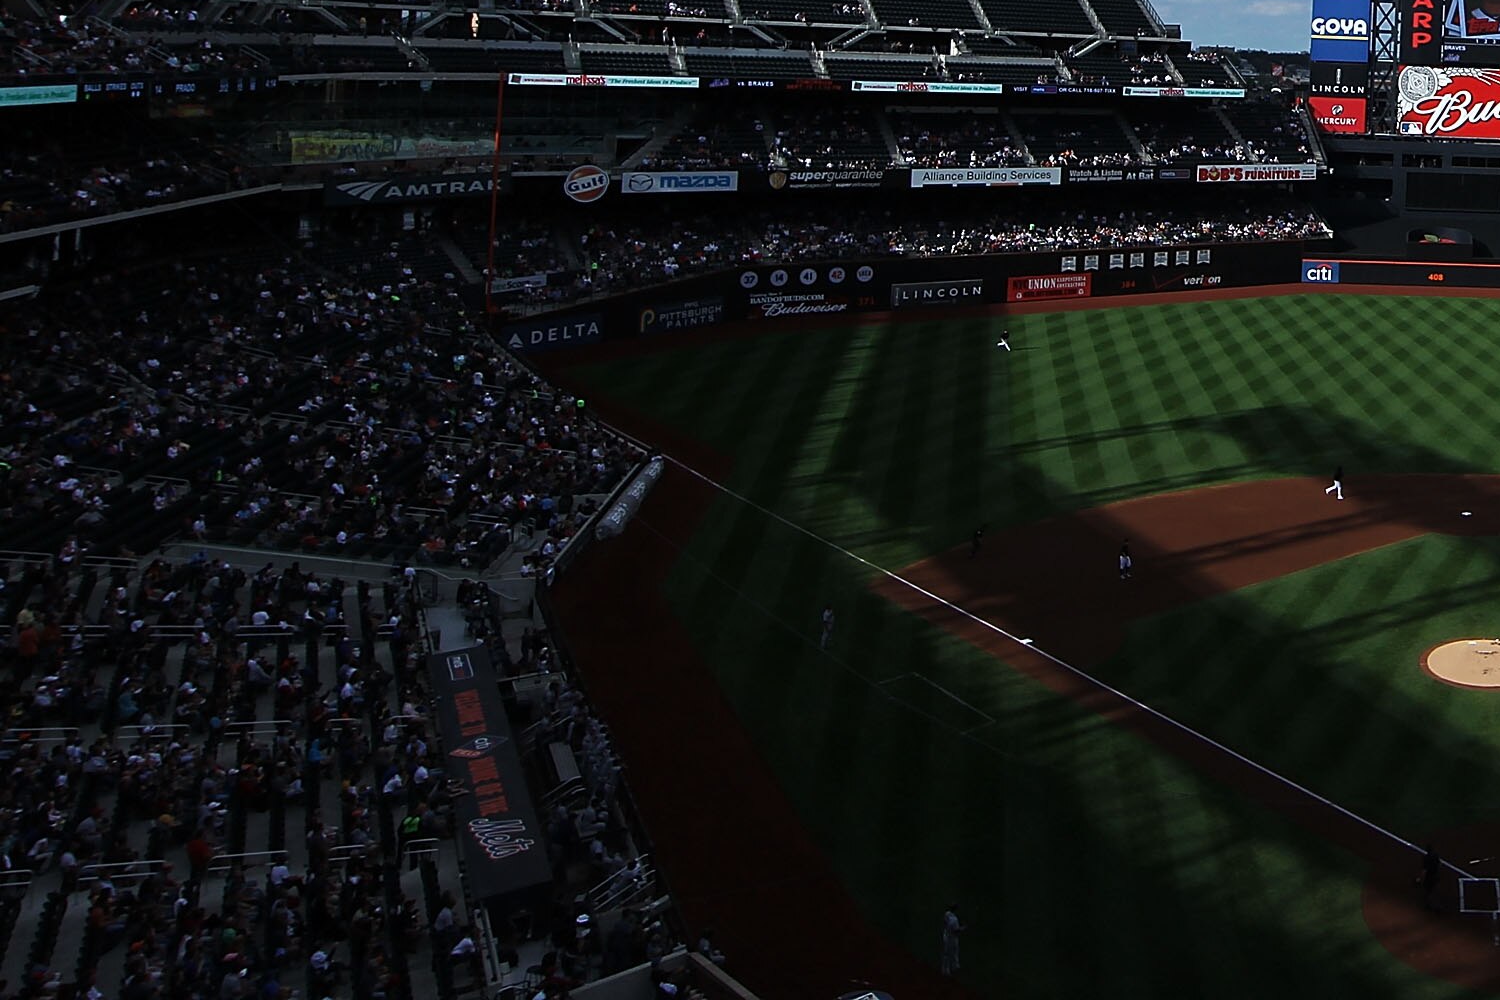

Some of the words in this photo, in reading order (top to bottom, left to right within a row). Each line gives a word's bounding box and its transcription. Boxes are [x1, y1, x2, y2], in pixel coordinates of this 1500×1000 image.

[1311, 18, 1367, 35] GOYA
[566, 74, 605, 86] melissa's
[176, 83, 196, 93] PRADO
[897, 81, 929, 92] melissa's
[1312, 84, 1364, 93] LINCOLN
[790, 170, 883, 182] superguarantee
[923, 172, 963, 181] Alliance
[967, 171, 1007, 182] Building
[1010, 171, 1051, 180] Services
[1069, 169, 1091, 177] Watch
[1100, 168, 1122, 176] Listen
[1126, 171, 1137, 180] At
[1139, 171, 1154, 180] Bat
[1200, 167, 1243, 180] BOB'S
[1244, 170, 1301, 180] FURNITURE
[386, 178, 504, 198] AMTRAK
[567, 175, 606, 193] Gulf
[660, 176, 731, 188] mazda
[803, 272, 814, 280] 41
[1307, 266, 1332, 281] citi
[1428, 273, 1444, 281] 408
[743, 275, 755, 285] 37
[1028, 278, 1056, 289] UNION
[1184, 275, 1221, 286] verizon
[902, 286, 982, 300] LINCOLN
[659, 304, 722, 321] PITTSBURGH
[761, 301, 847, 317] Budweiser
[667, 314, 715, 328] PAINTS
[531, 321, 600, 345] DELTA
[468, 818, 535, 860] Mets
